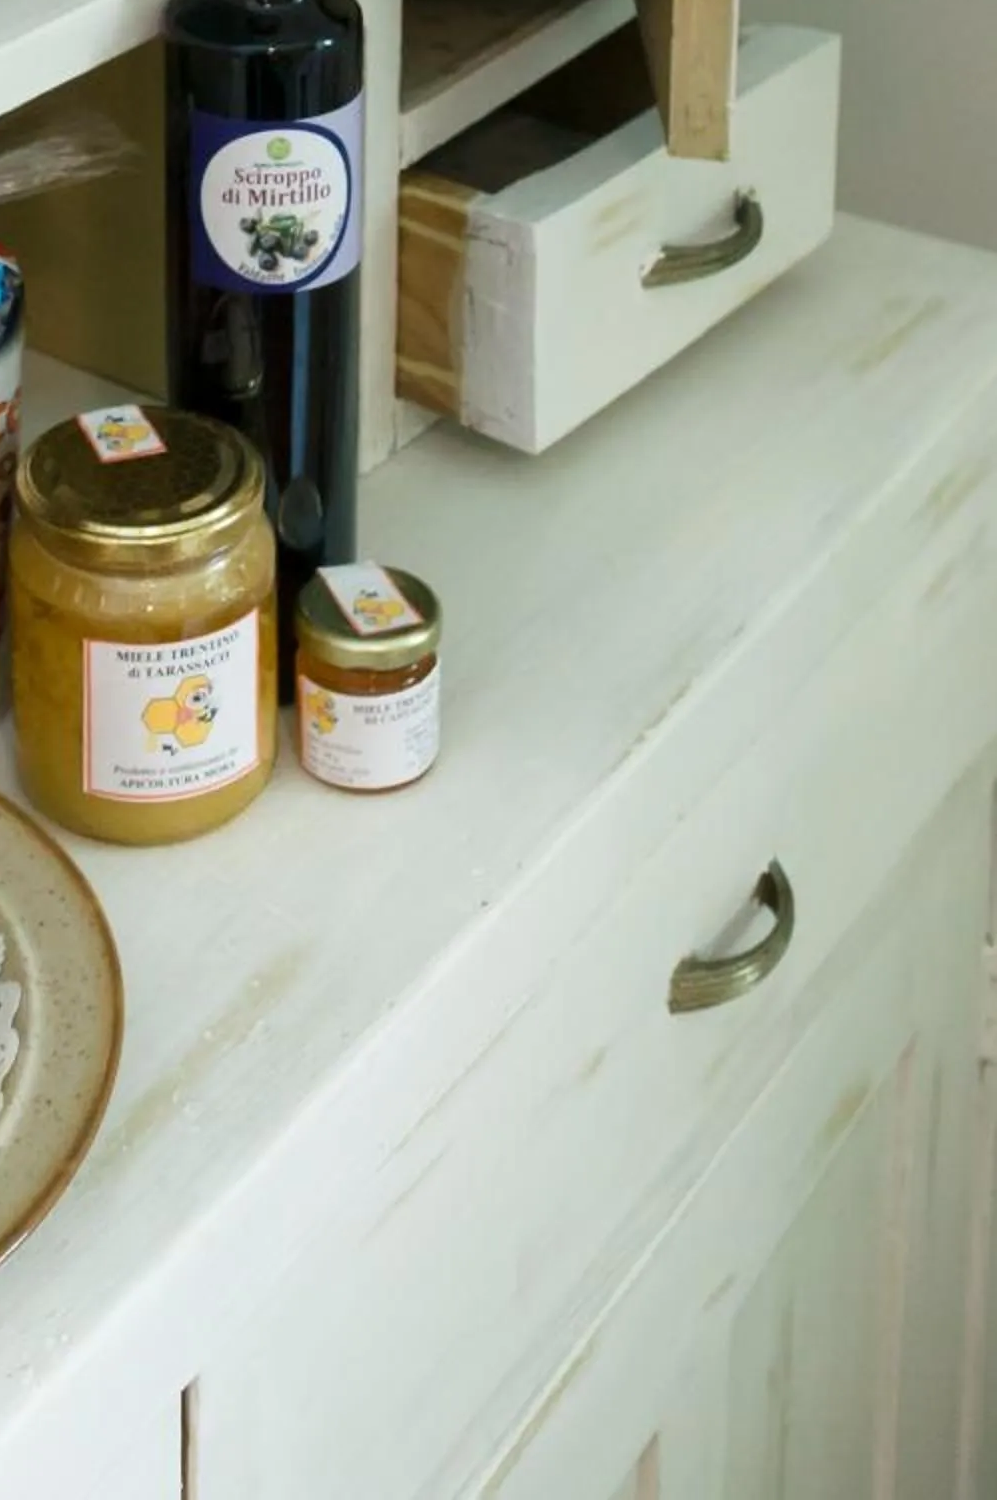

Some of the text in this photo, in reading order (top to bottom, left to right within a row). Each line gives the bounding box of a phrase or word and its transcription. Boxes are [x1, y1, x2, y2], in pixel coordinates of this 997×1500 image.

[234, 166, 322, 188] Sciroppo
[222, 183, 332, 207] di Mirtillo
[116, 630, 240, 663] MIELE TRENTINO
[128, 650, 230, 679] di TARASSACO
[119, 773, 200, 789] APICOLTURA
